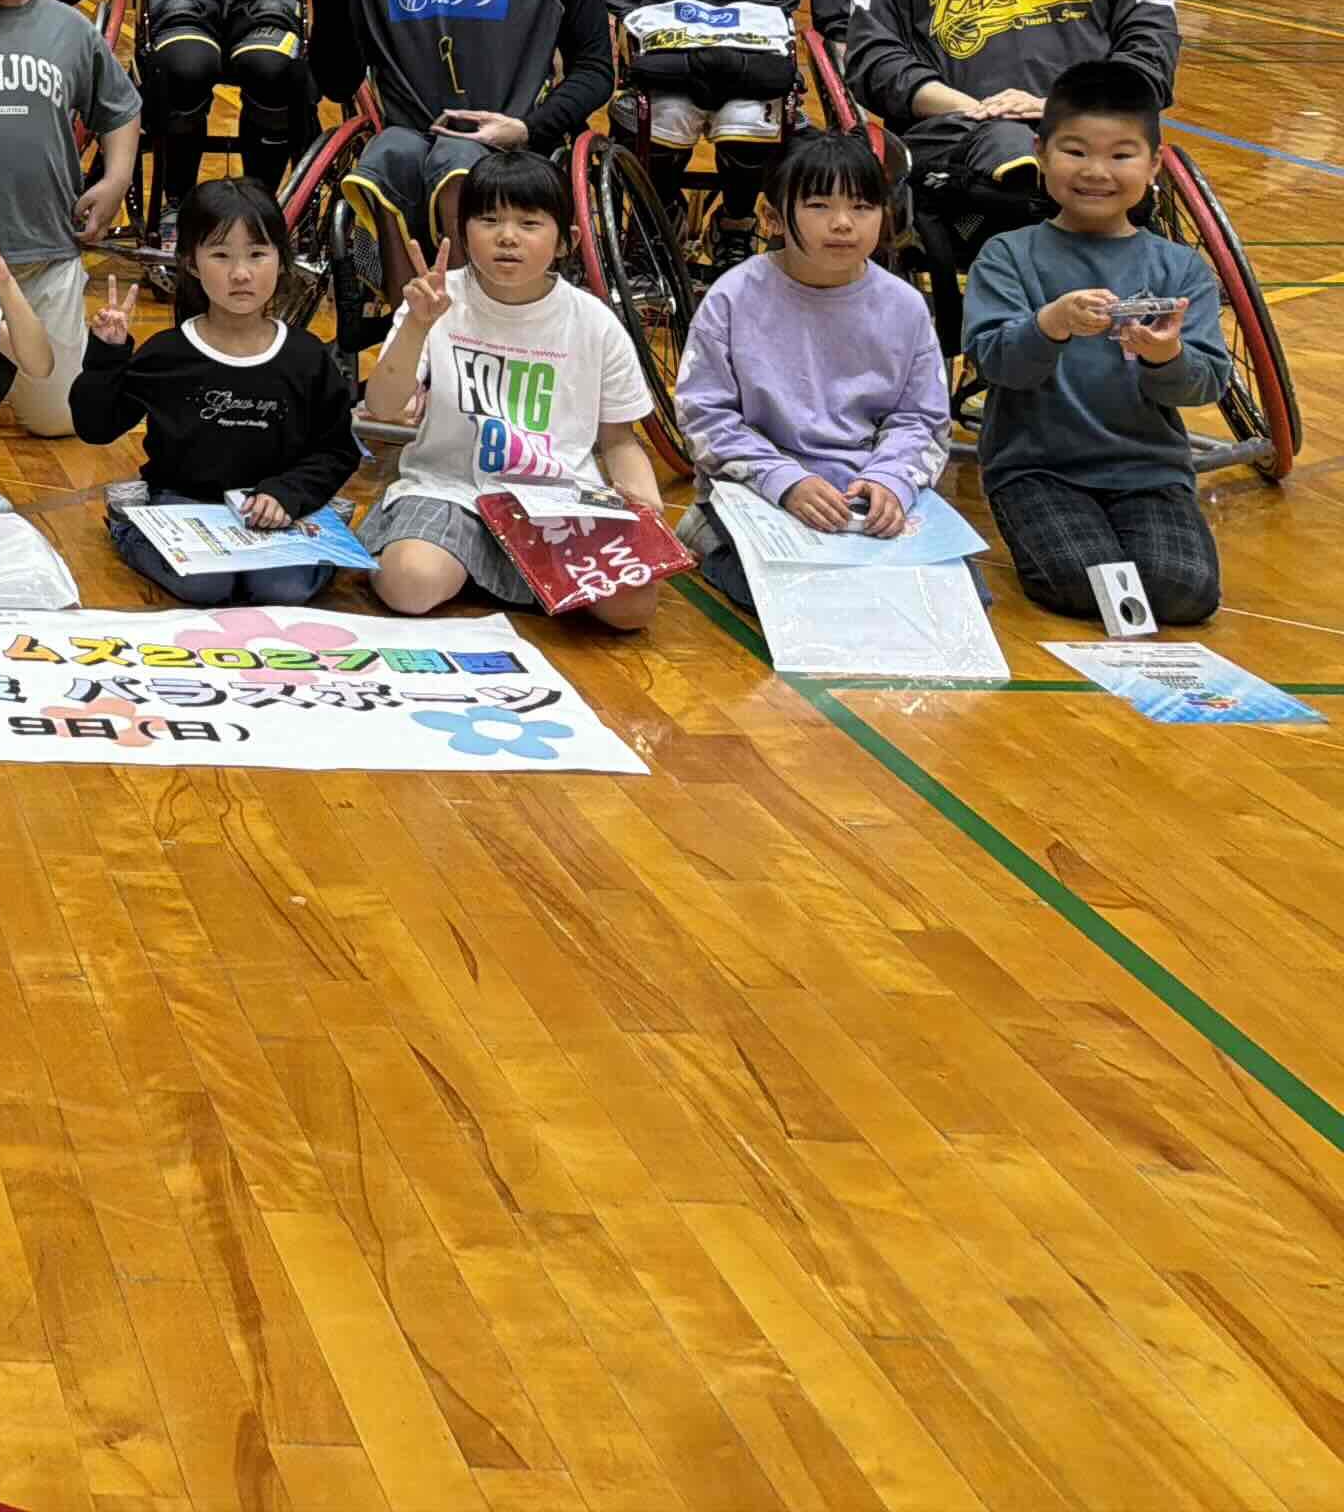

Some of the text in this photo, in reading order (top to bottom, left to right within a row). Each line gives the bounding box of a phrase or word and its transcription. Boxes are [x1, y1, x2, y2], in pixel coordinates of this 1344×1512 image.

[63, 674, 562, 713] パラスポーツ
